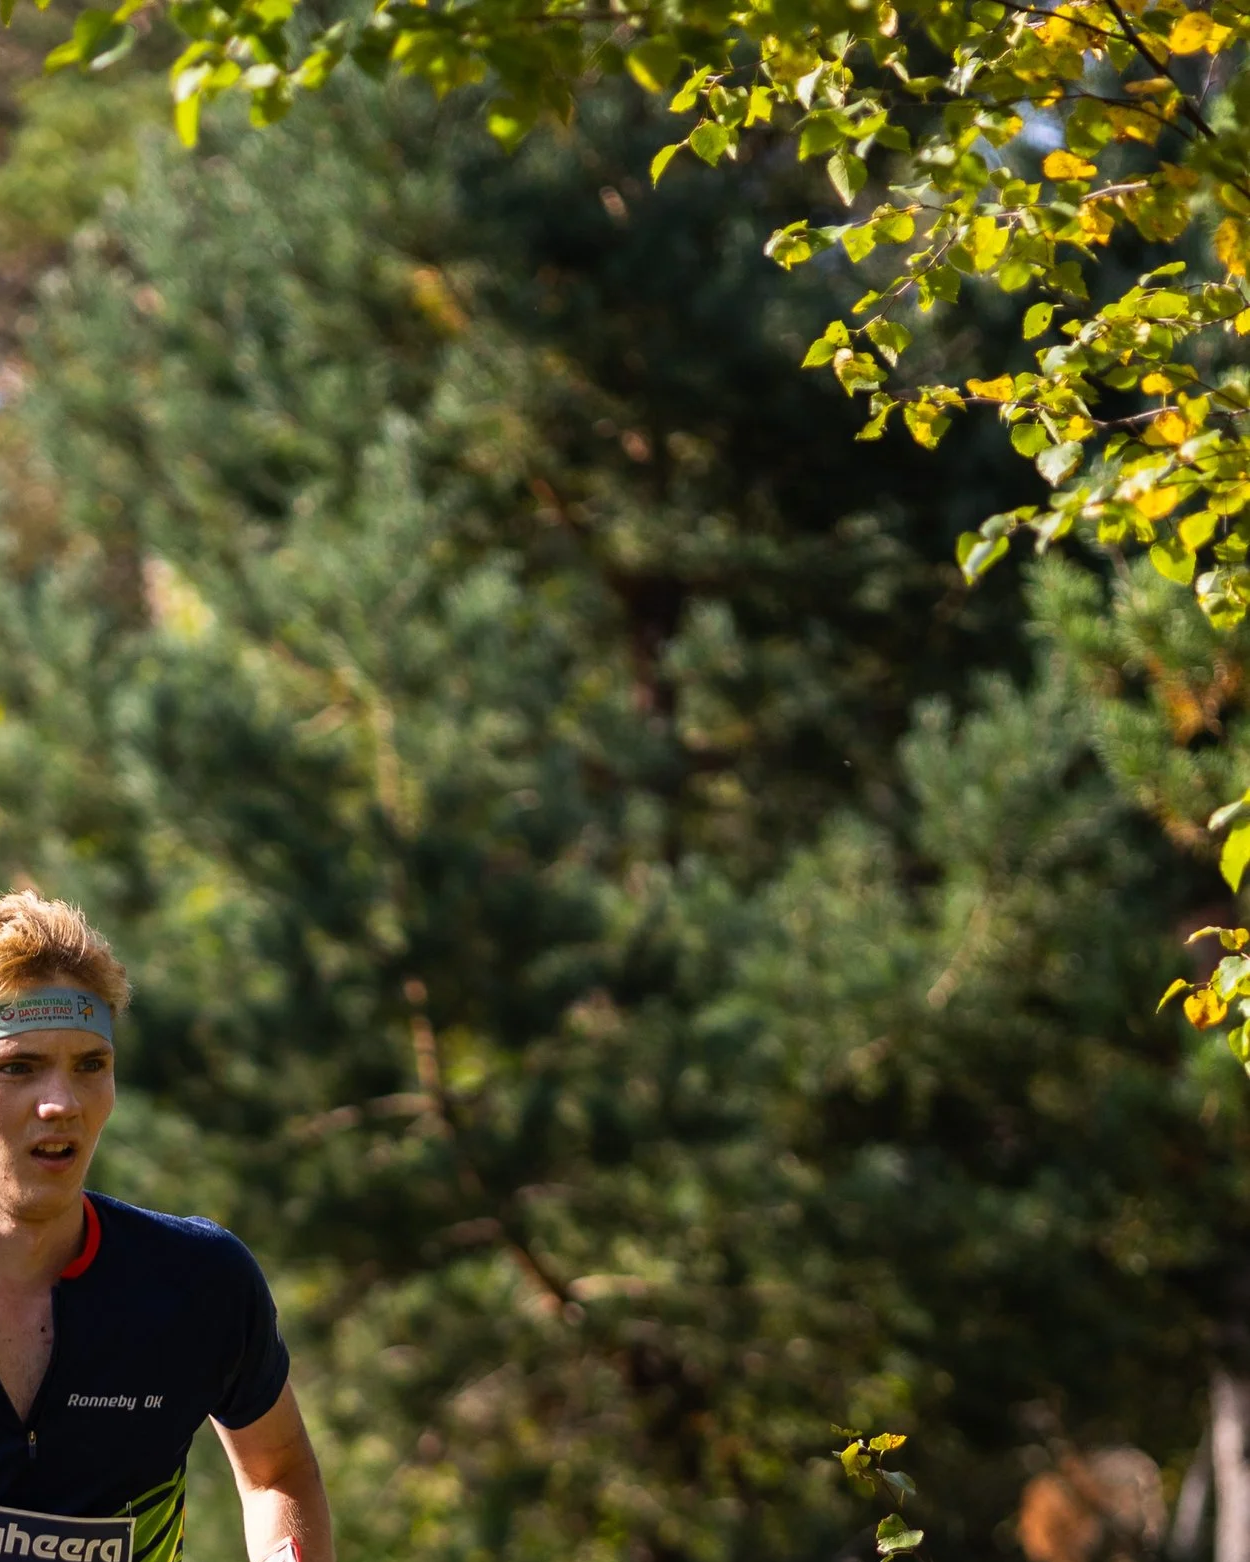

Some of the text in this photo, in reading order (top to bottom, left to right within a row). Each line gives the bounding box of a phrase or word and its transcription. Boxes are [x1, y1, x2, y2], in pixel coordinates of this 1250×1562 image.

[18, 1007, 72, 1017] DAYS OF ITALY
[67, 1393, 164, 1410] Ronneby OK
